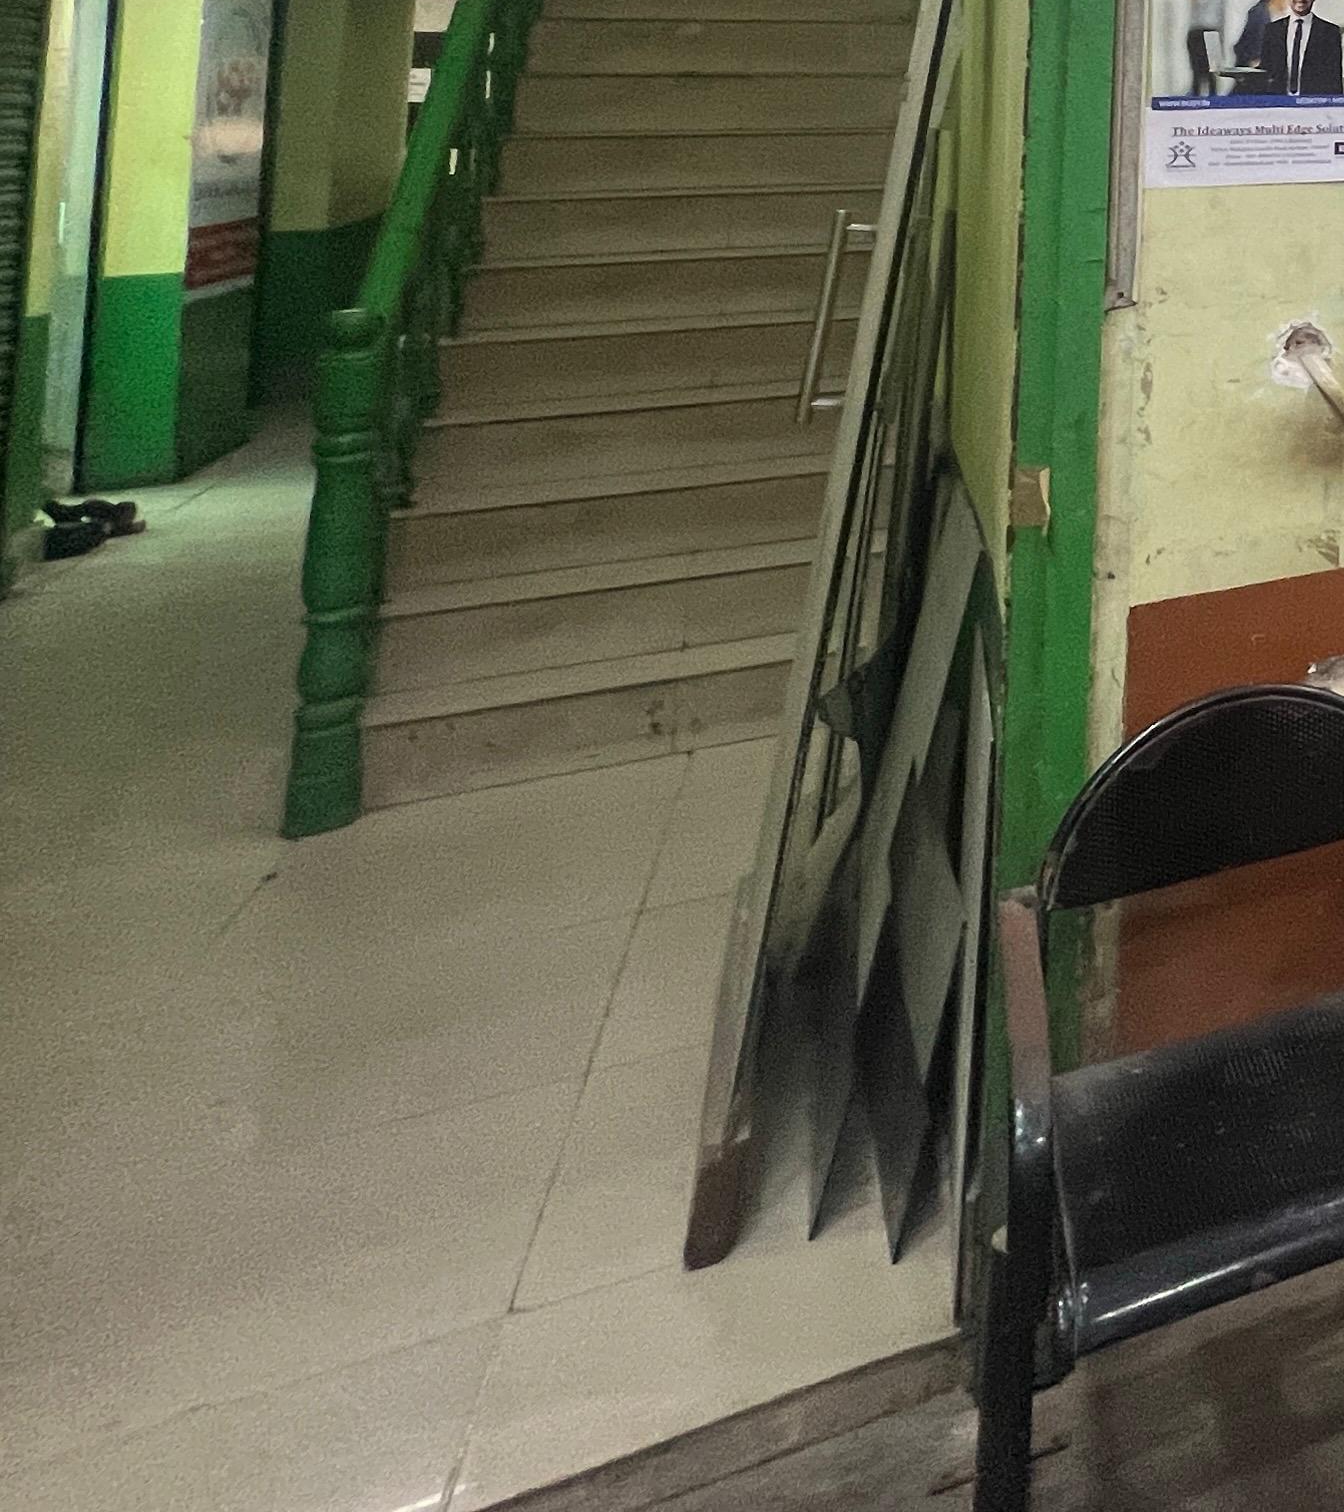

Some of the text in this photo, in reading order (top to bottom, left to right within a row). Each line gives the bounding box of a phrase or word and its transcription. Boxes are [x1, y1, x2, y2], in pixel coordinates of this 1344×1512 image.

[1173, 127, 1194, 137] The
[1197, 126, 1251, 137] Ideaways
[1255, 125, 1285, 136] Multi
[1288, 125, 1313, 136] Edge
